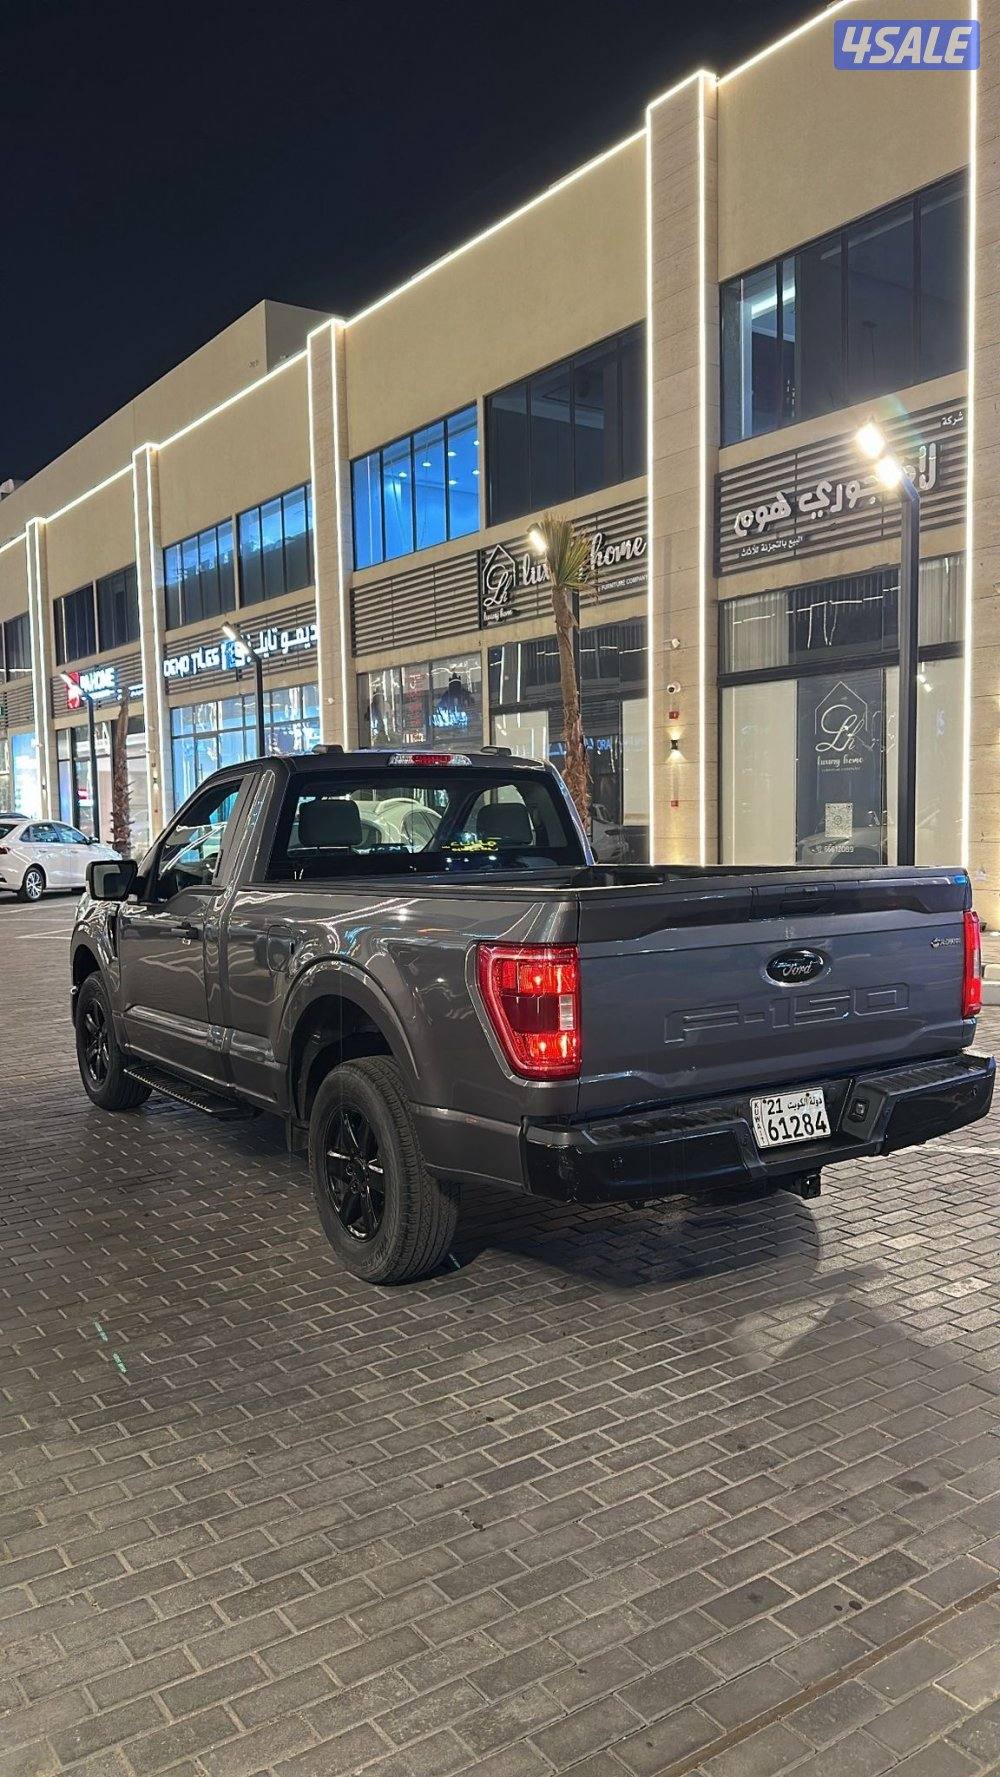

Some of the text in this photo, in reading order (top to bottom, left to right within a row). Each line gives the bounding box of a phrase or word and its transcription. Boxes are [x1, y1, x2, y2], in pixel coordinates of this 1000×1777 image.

[942, 411, 964, 426] شركة
[734, 490, 791, 537] هوم
[589, 532, 647, 570] home
[782, 960, 814, 977] Ford
[664, 982, 910, 1044] F-150
[767, 1098, 784, 1116] 21
[809, 1096, 823, 1107] دولة
[767, 1110, 827, 1142] 61284
